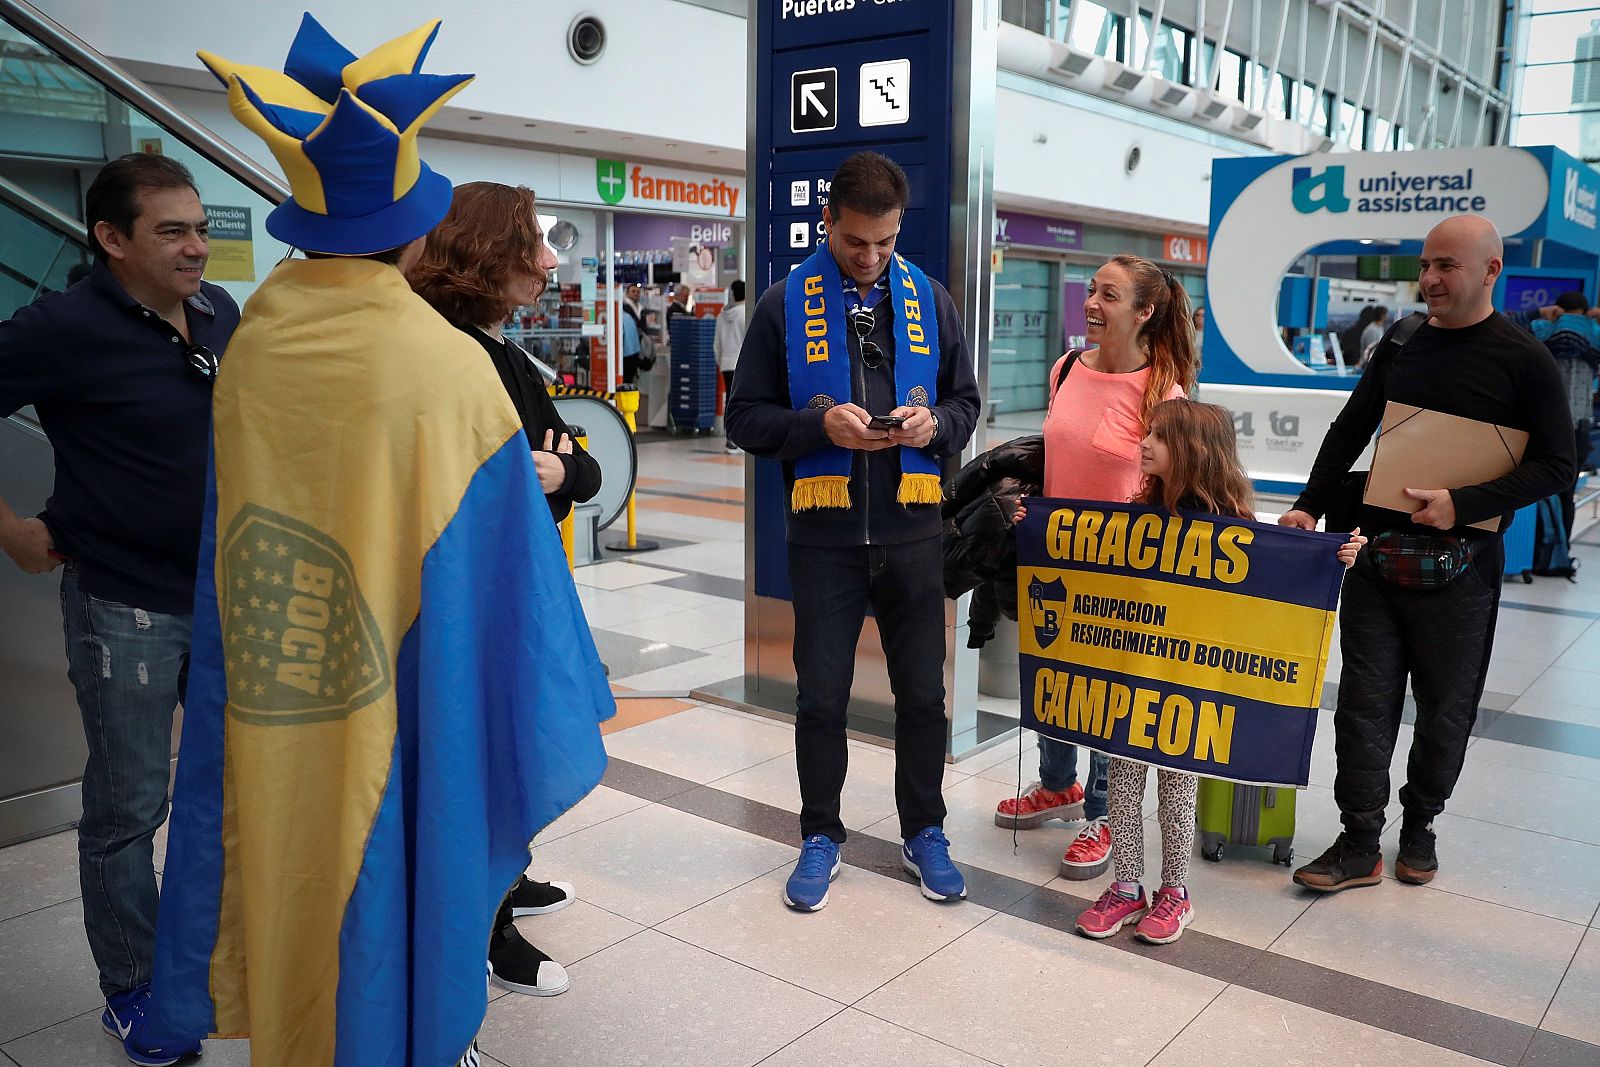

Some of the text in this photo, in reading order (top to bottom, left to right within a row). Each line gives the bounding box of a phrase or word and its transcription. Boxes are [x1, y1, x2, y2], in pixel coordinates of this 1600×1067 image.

[782, 0, 855, 20] Puertas
[630, 166, 739, 217] farmacity
[794, 185, 807, 193] TAX
[817, 179, 832, 193] Re
[1358, 168, 1473, 193] universal
[206, 208, 246, 220] Atención
[1356, 193, 1487, 214] assistance
[215, 219, 247, 230] Cliente
[690, 223, 732, 242] Belle
[1169, 236, 1193, 261] GOL
[804, 274, 830, 365] BOCA
[1045, 508, 1256, 584] GRACIAS
[1072, 593, 1167, 627] AGRUPACION
[1070, 622, 1300, 685] RESURGIMIENTO BOQUENSE
[1033, 667, 1236, 765] CAMPEON
